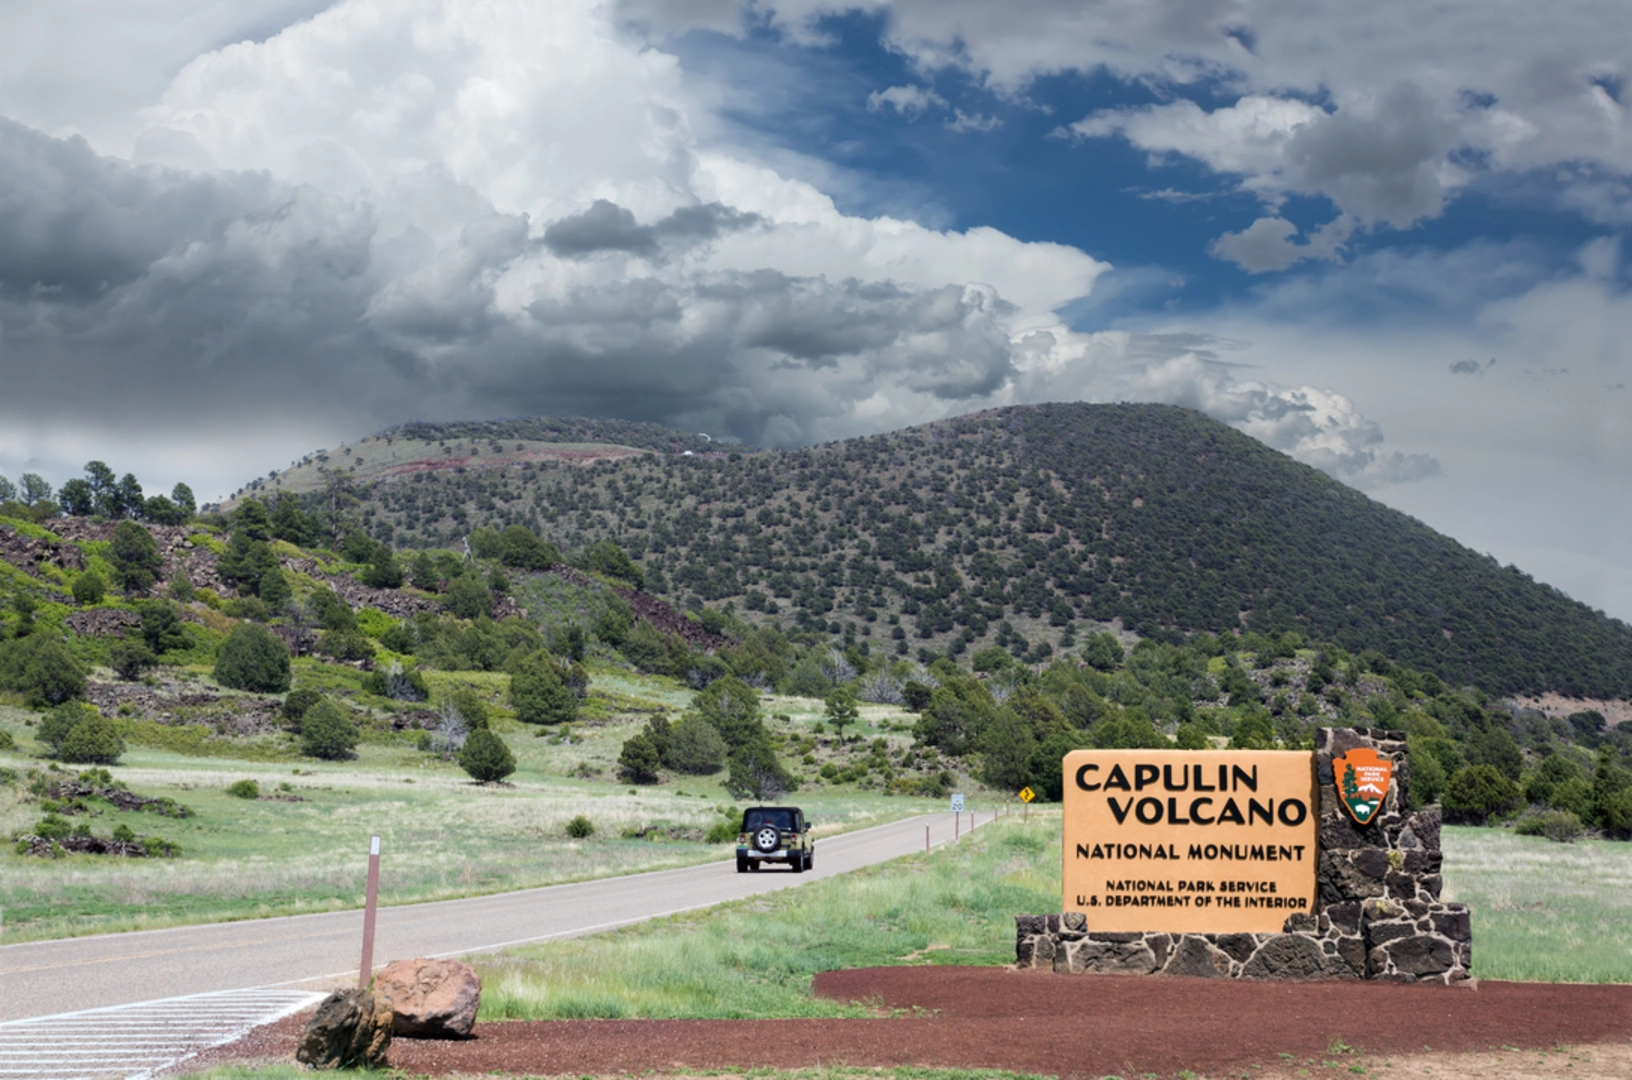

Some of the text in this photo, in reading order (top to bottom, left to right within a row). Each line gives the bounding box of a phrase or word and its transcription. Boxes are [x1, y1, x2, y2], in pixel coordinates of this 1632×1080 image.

[1075, 763, 1258, 792] CAPULIN
[952, 803, 964, 811] 20
[1106, 796, 1308, 827] VOLCANO
[1076, 843, 1306, 861] NATIONAL MONUMENT
[1106, 879, 1277, 893] NATIONAL PARK SERVICE
[1076, 894, 1308, 909] U.S. DEPARTMENT OF THE INTERIOR
